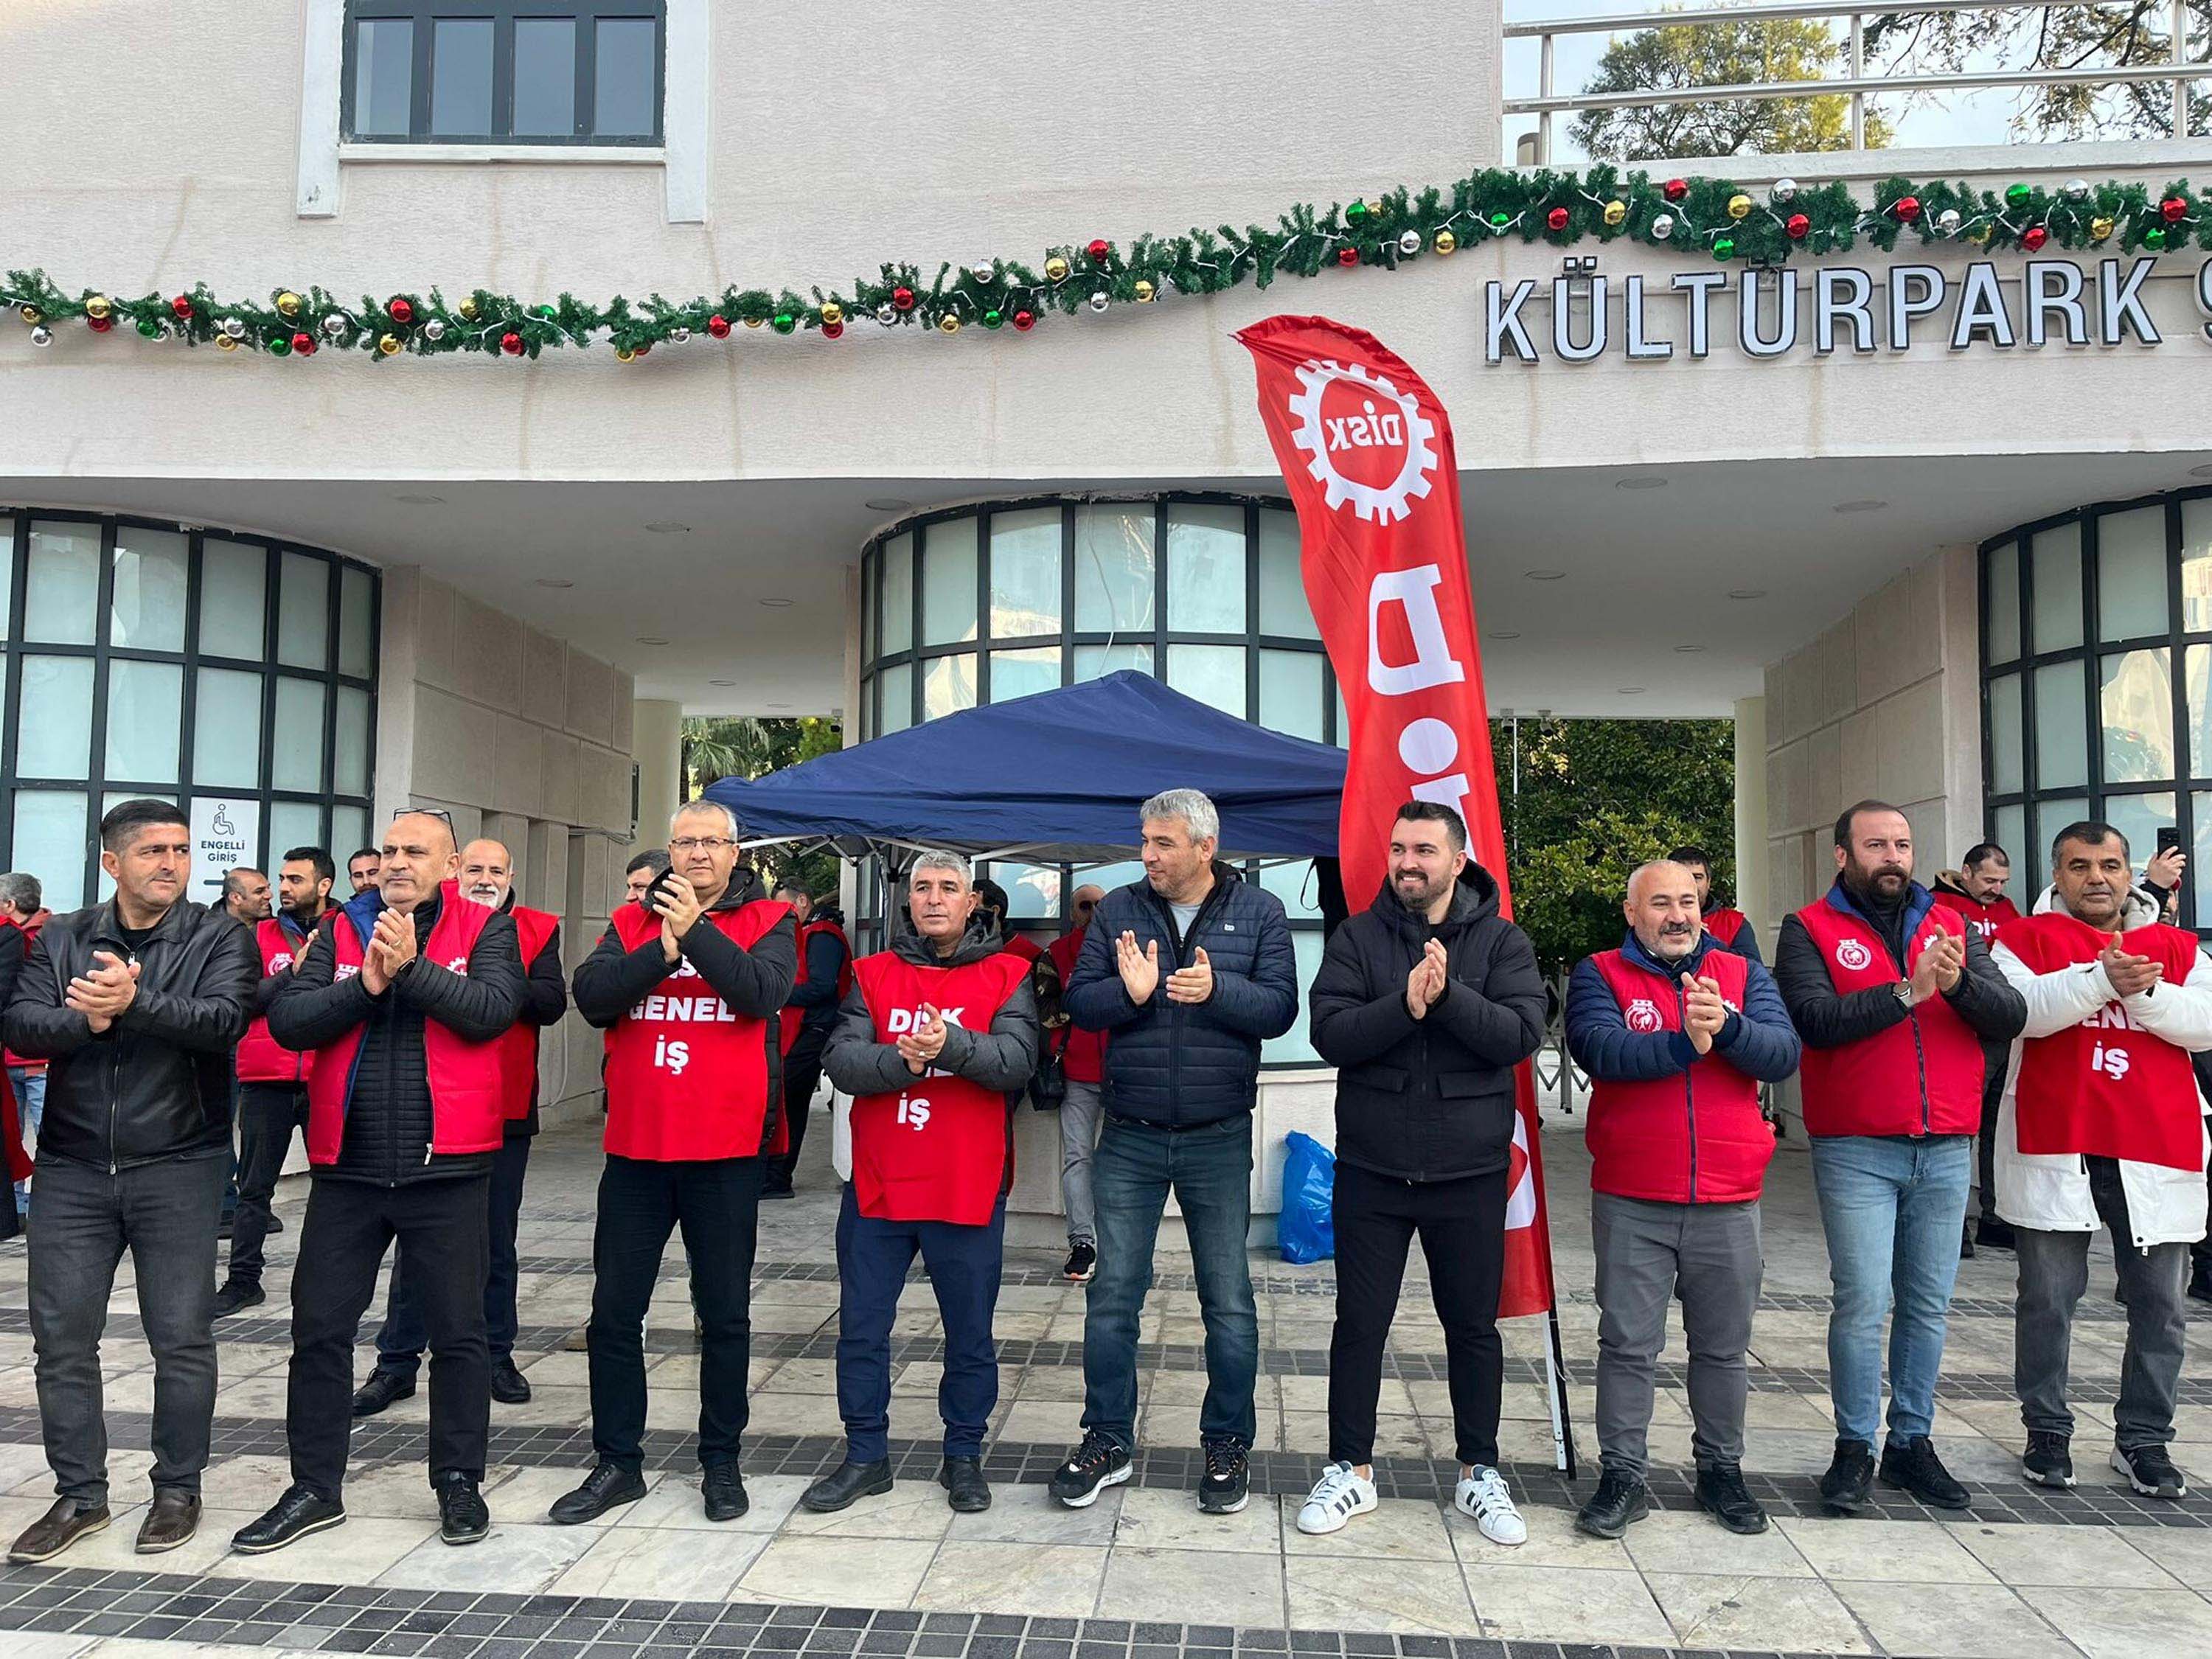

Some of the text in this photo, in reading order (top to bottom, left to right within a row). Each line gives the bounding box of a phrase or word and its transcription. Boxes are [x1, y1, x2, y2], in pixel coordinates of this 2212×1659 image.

[1485, 252, 2163, 364] KÜLTÜRPARK
[201, 840, 246, 849] ENGELLİ
[207, 851, 237, 863] GİRİŞ
[654, 1034, 689, 1075] İŞ
[2092, 1040, 2130, 1080] İŞ
[897, 1092, 931, 1131] İŞ
